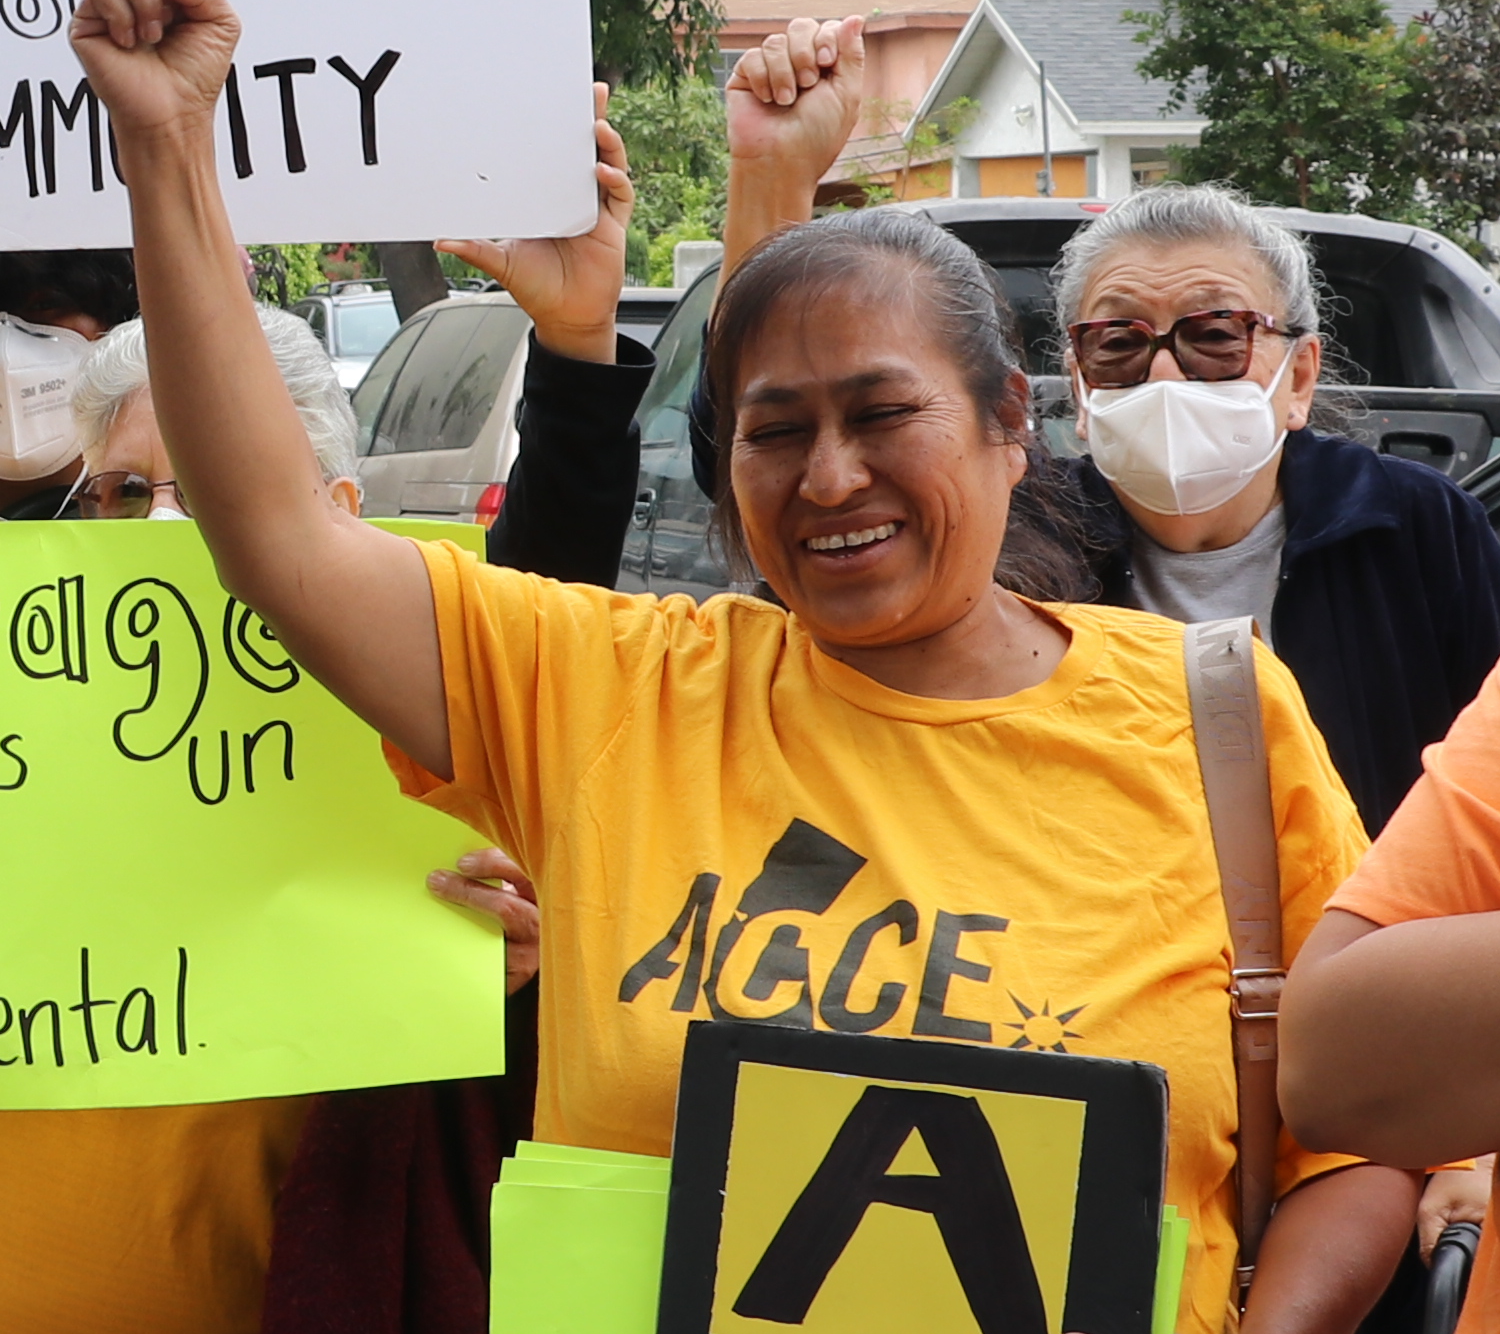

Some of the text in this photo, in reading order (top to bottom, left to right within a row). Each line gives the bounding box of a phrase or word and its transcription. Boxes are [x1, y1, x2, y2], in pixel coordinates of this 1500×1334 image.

[21, 378, 67, 399] 3M 9502+
[187, 718, 295, 806] un
